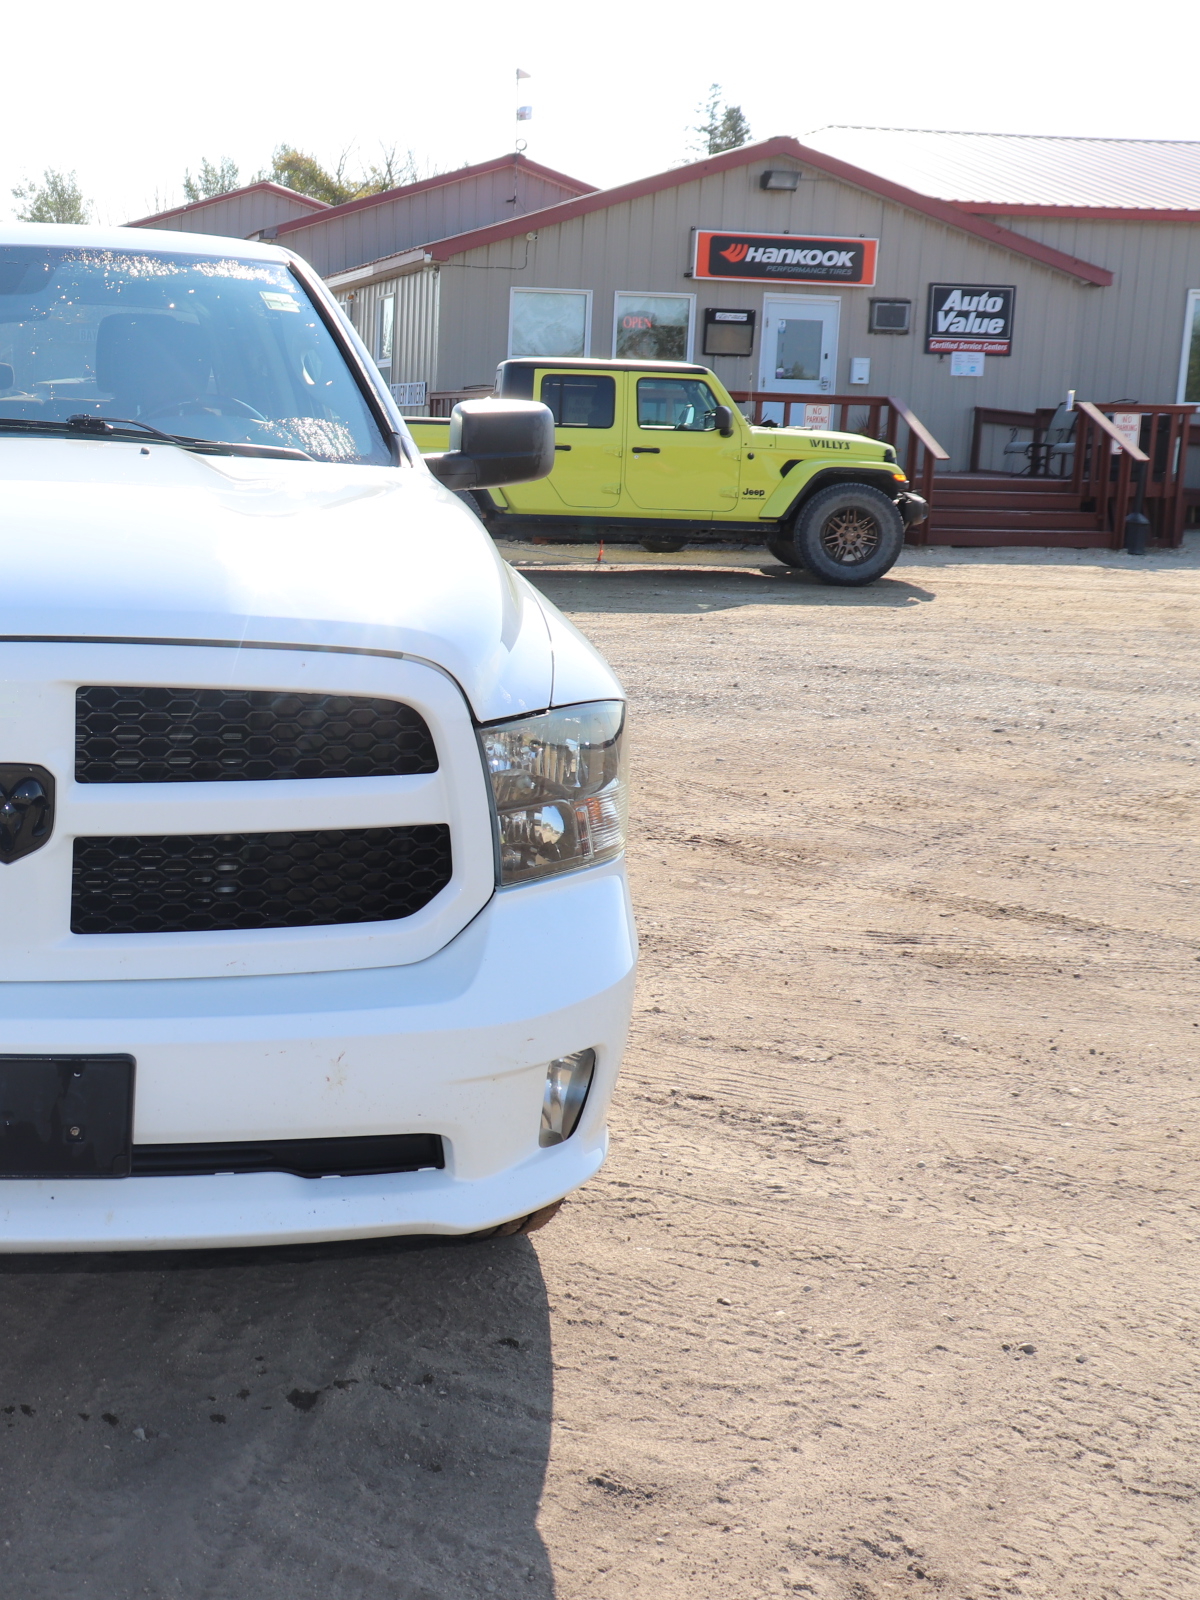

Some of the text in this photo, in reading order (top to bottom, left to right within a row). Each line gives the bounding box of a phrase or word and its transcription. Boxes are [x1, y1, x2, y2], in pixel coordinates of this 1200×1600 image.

[766, 266, 827, 275] PERFORMANCE
[941, 289, 1004, 313] Auto
[622, 316, 653, 329] OPEN
[937, 311, 1005, 334] Value
[930, 341, 1008, 351] Certified Service Centers
[812, 407, 823, 415] NO
[807, 416, 828, 424] PARKING
[809, 439, 851, 450] WILLYS
[743, 488, 765, 497] Jeep
